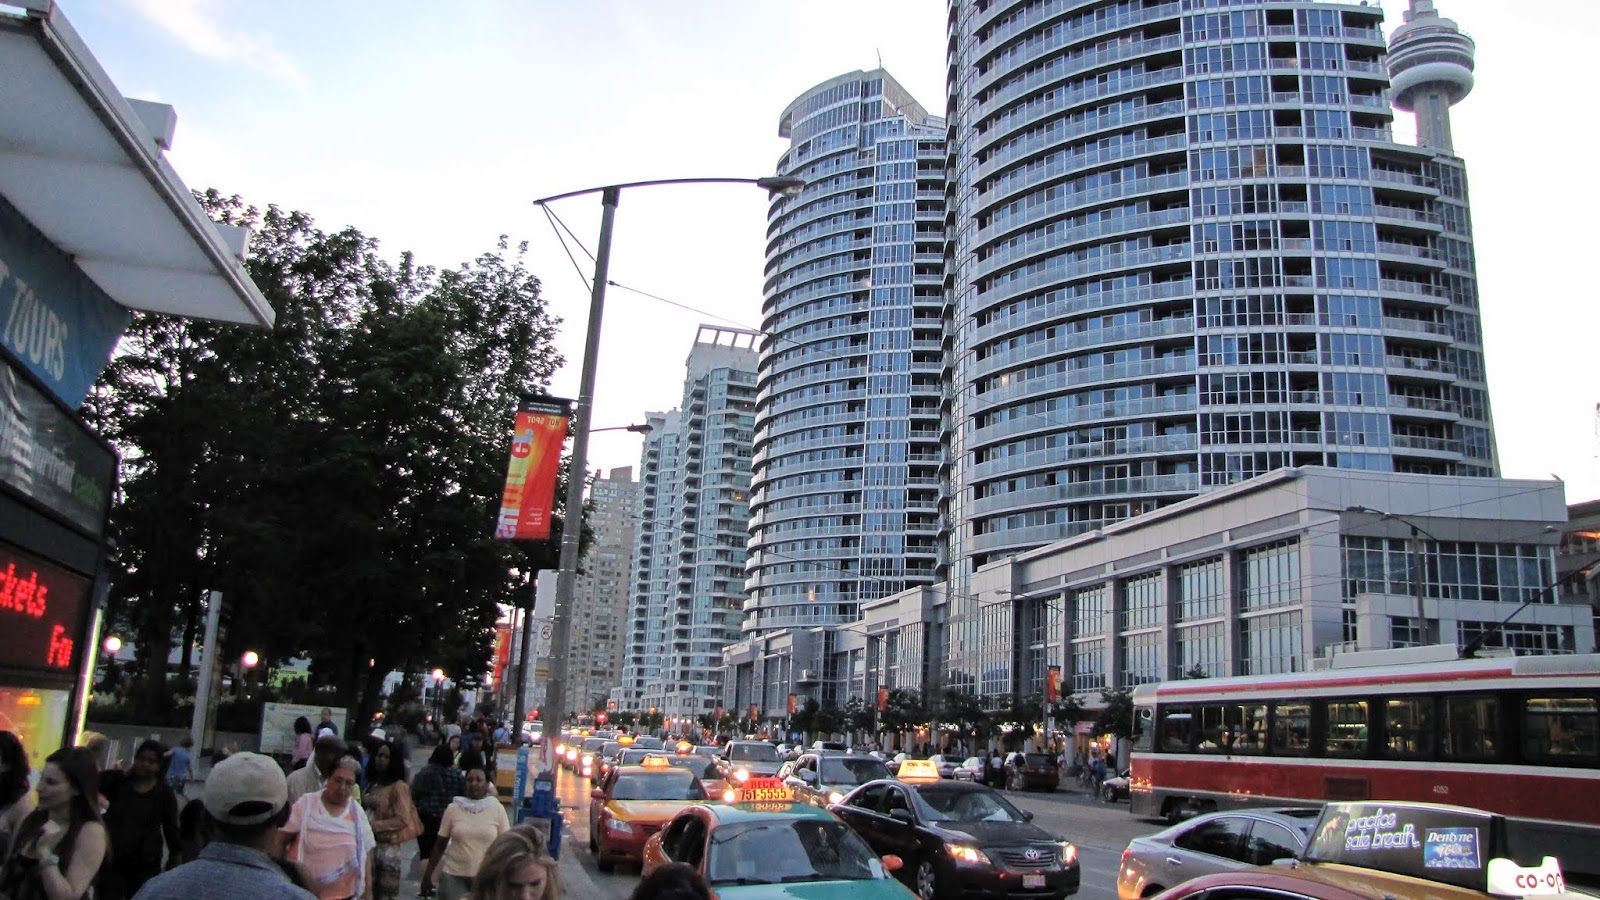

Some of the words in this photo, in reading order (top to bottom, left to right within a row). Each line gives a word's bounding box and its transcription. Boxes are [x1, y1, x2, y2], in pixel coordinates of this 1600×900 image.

[4, 276, 69, 381] TOURS
[751, 780, 776, 789] BECK
[740, 788, 787, 800] 751-5555
[1345, 808, 1396, 838] practice
[1345, 829, 1371, 850] safe
[1427, 832, 1473, 843] Dentyne
